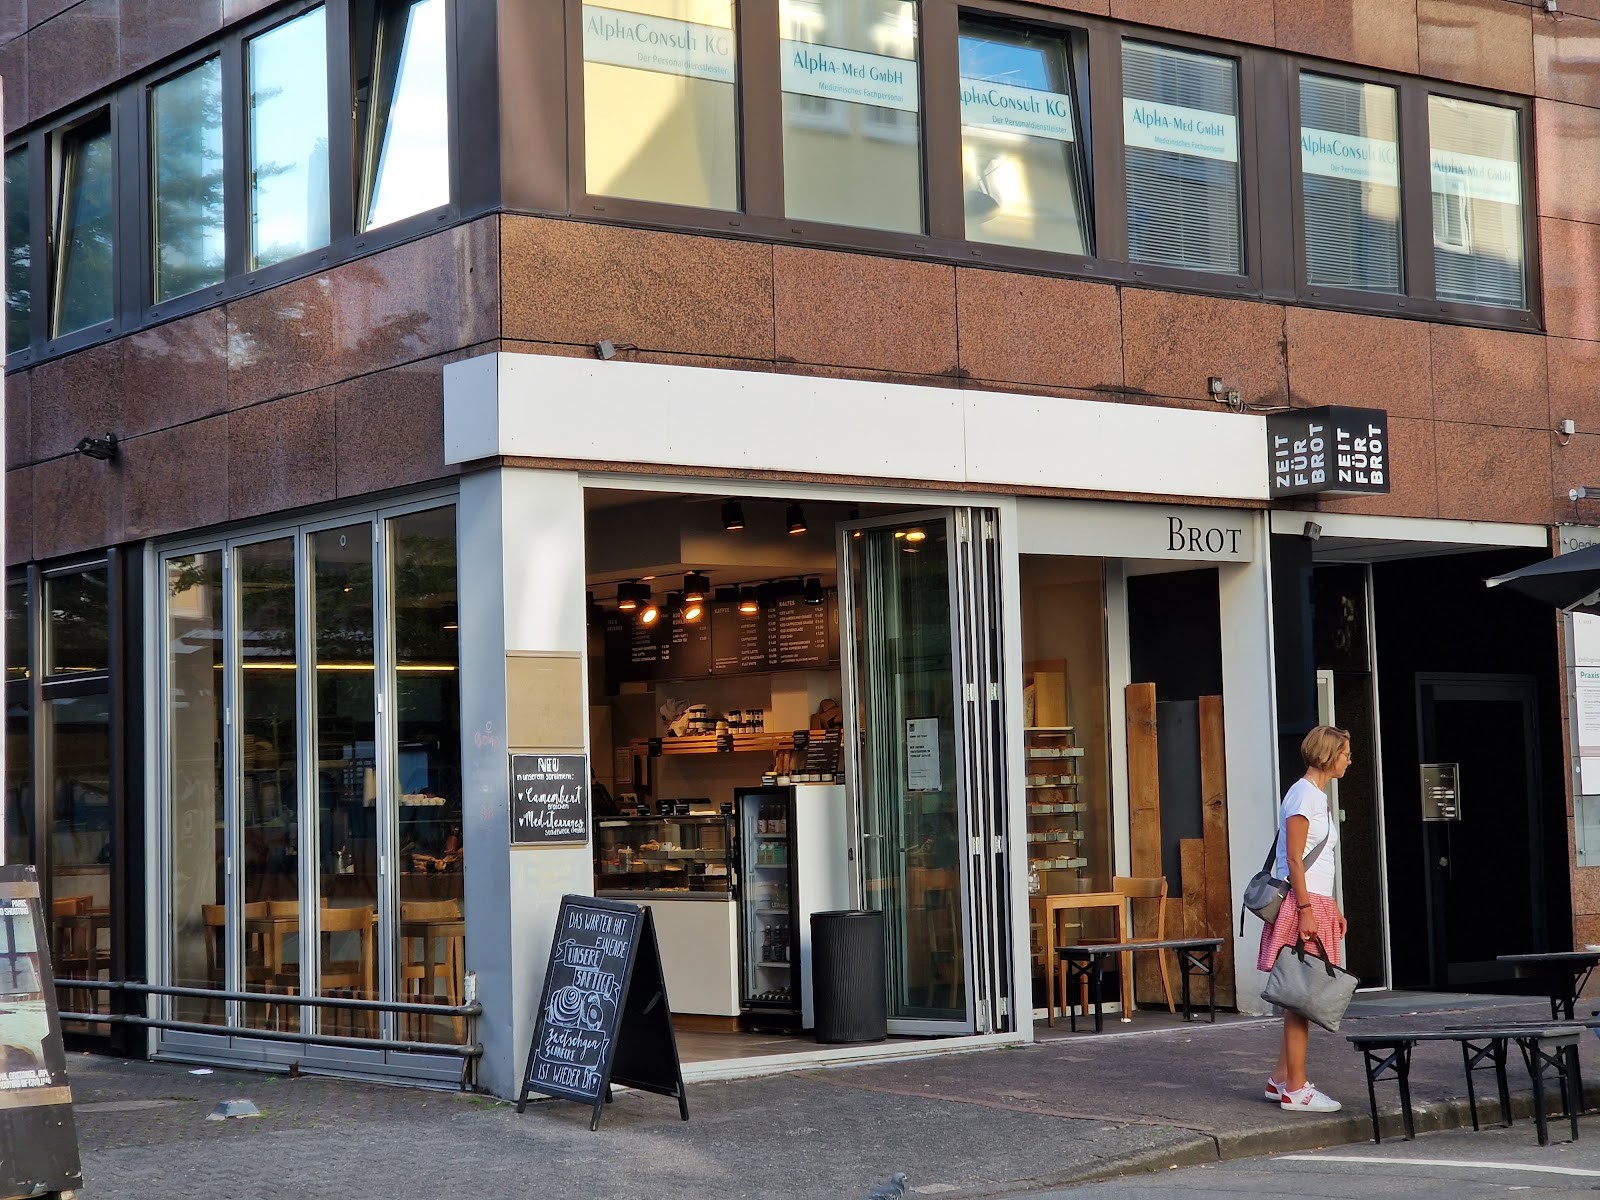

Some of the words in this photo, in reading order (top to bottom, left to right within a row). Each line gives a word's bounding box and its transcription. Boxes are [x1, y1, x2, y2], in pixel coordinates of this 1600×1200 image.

[705, 35, 729, 57] KG
[637, 52, 651, 63] Der
[652, 54, 728, 76] Personaldienstleister
[870, 68, 903, 85] GmbH
[818, 81, 862, 97] Medizinisches
[863, 87, 904, 103] Fachpersonal
[1046, 99, 1067, 118] KG
[992, 115, 1003, 124] Der
[1004, 117, 1067, 134] Personaldienstleister
[1196, 121, 1225, 138] GmbH
[1275, 435, 1291, 488] ZEIT
[1291, 438, 1309, 486] FÜR
[1309, 423, 1326, 484] BROT
[1337, 428, 1352, 483] ZEIT
[1351, 437, 1369, 485] FÜR
[1368, 424, 1384, 485] BROT
[1580, 671, 1600, 679] Praxis
[538, 758, 560, 772] NEU
[568, 912, 583, 929] DAS
[584, 913, 613, 933] WARTEN
[613, 917, 627, 936] HAT
[568, 947, 601, 966] UNSERE
[538, 1063, 550, 1080] IST
[553, 1066, 581, 1087] WIEDER
